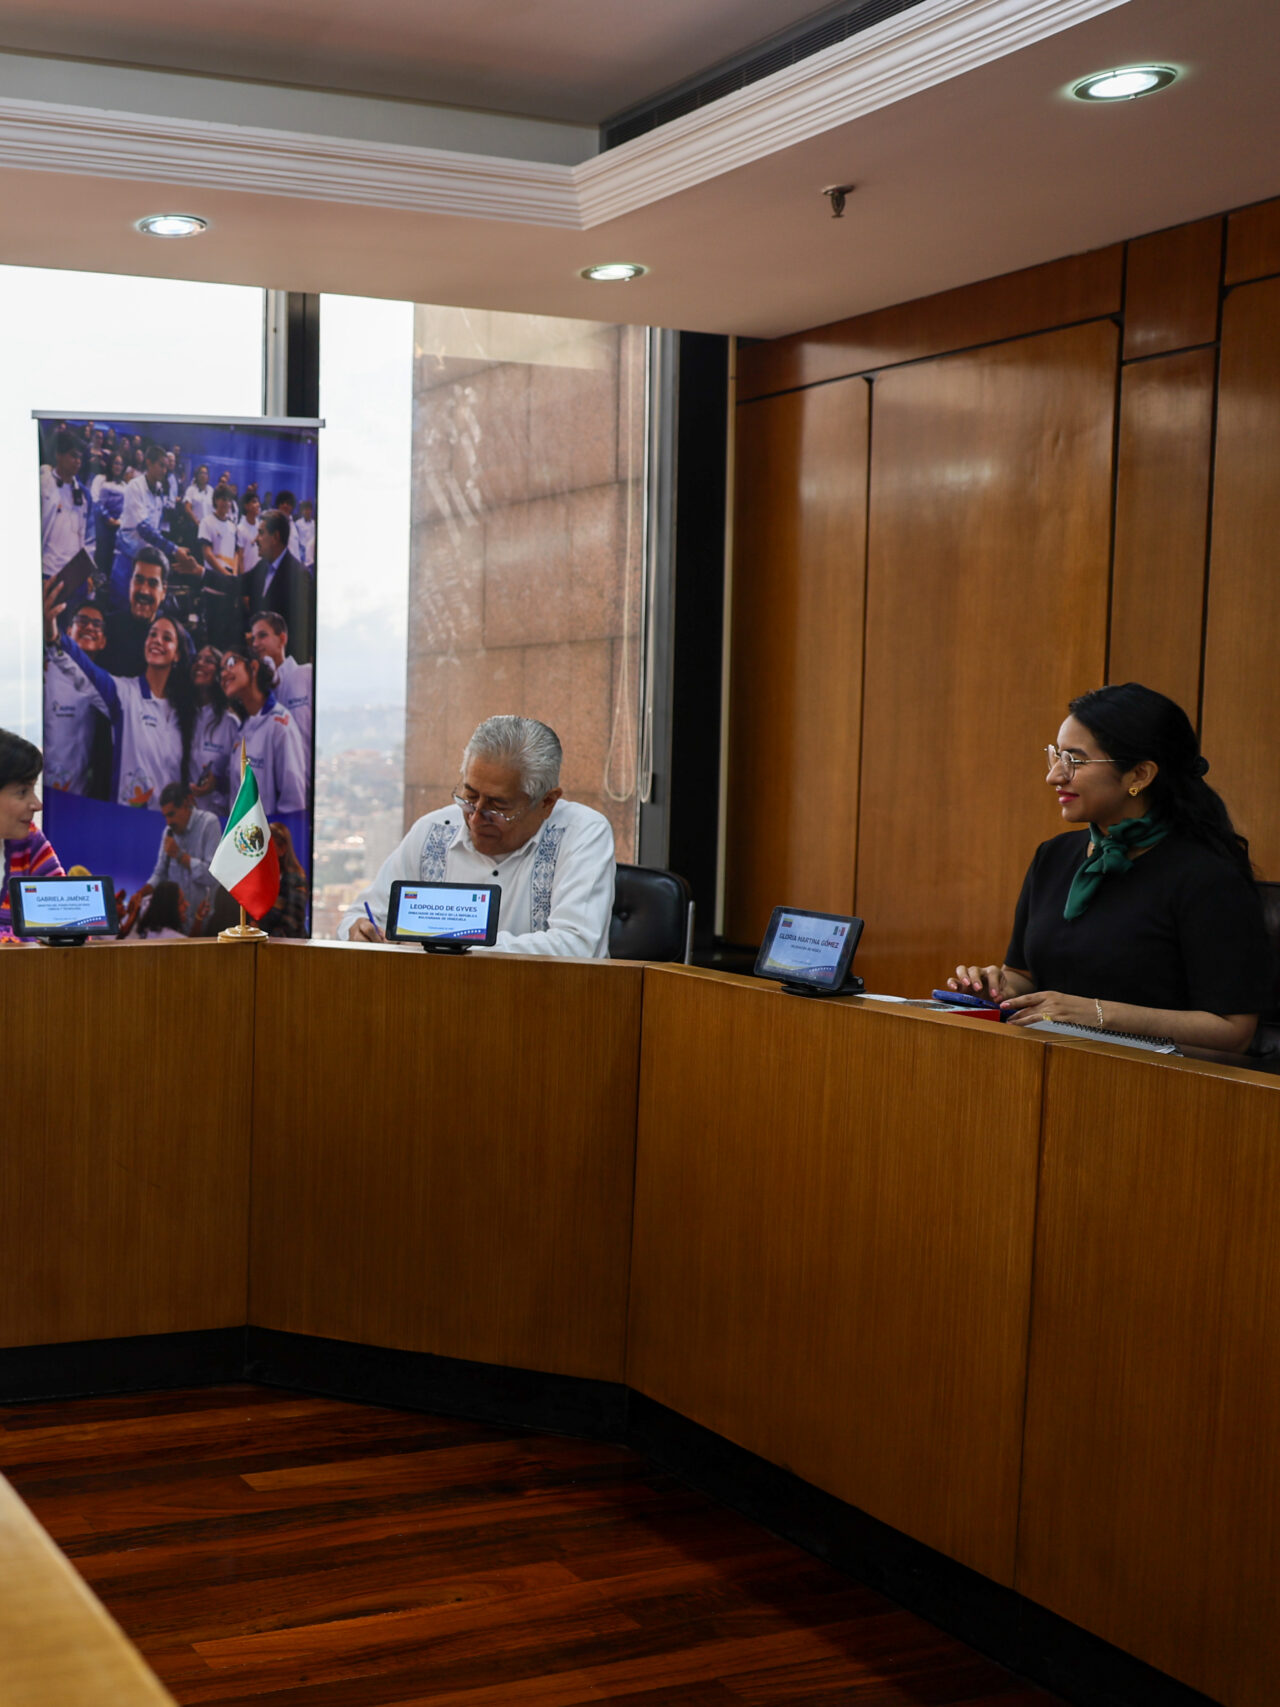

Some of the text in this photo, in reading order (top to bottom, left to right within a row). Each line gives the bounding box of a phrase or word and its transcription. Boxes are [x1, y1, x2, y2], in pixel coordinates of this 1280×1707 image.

[410, 903, 444, 911] LEOPOLDO
[779, 932, 840, 948] GLORIA MARTINA GÓMEZ
